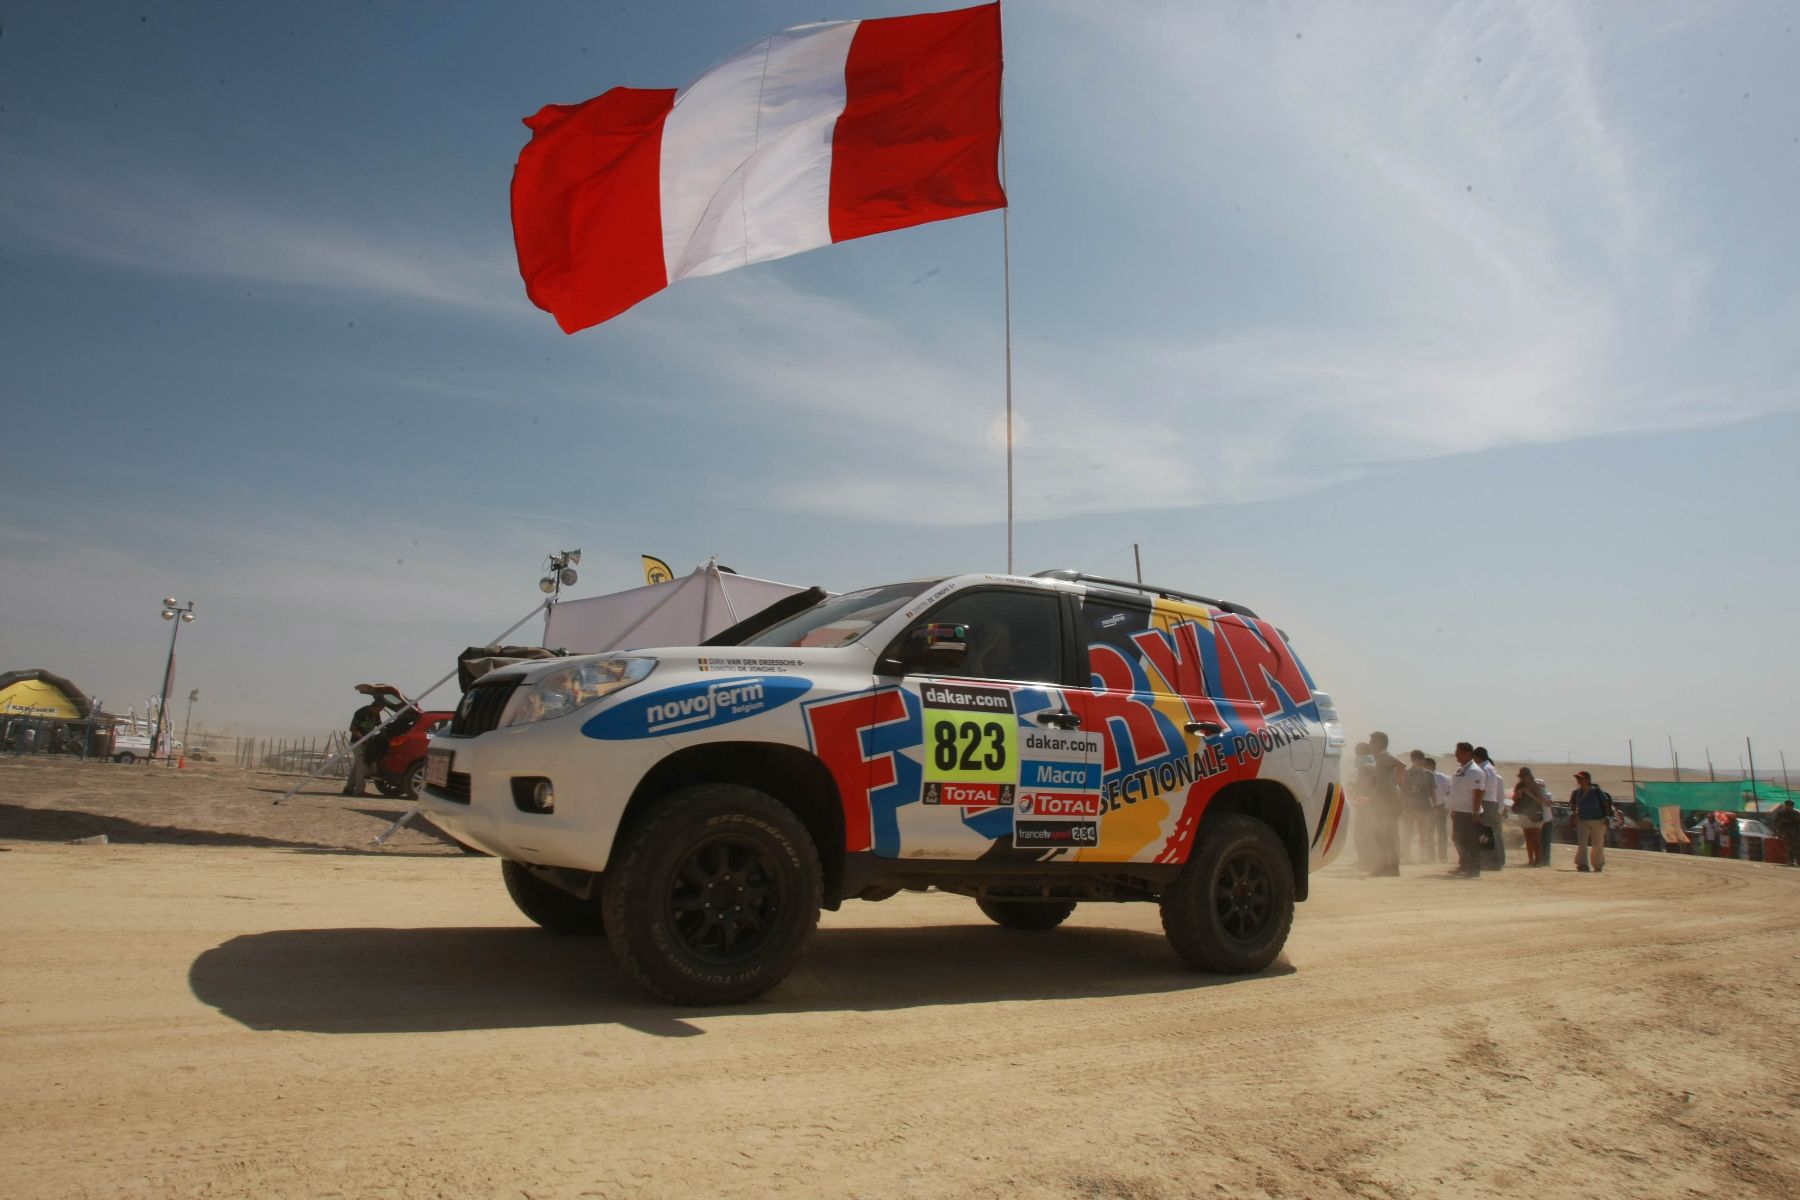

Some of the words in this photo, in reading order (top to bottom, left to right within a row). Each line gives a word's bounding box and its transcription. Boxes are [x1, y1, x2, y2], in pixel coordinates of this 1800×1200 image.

[646, 682, 765, 725] novoferm
[926, 688, 1009, 708] dakar.com
[806, 614, 1314, 852] FRYN
[1232, 713, 1309, 764] POORTEN
[934, 720, 1007, 772] 823
[1026, 734, 1098, 753] dakar.com
[1037, 765, 1087, 784] Macro
[943, 786, 997, 801] TOTAL
[1038, 796, 1097, 814] TOTAL
